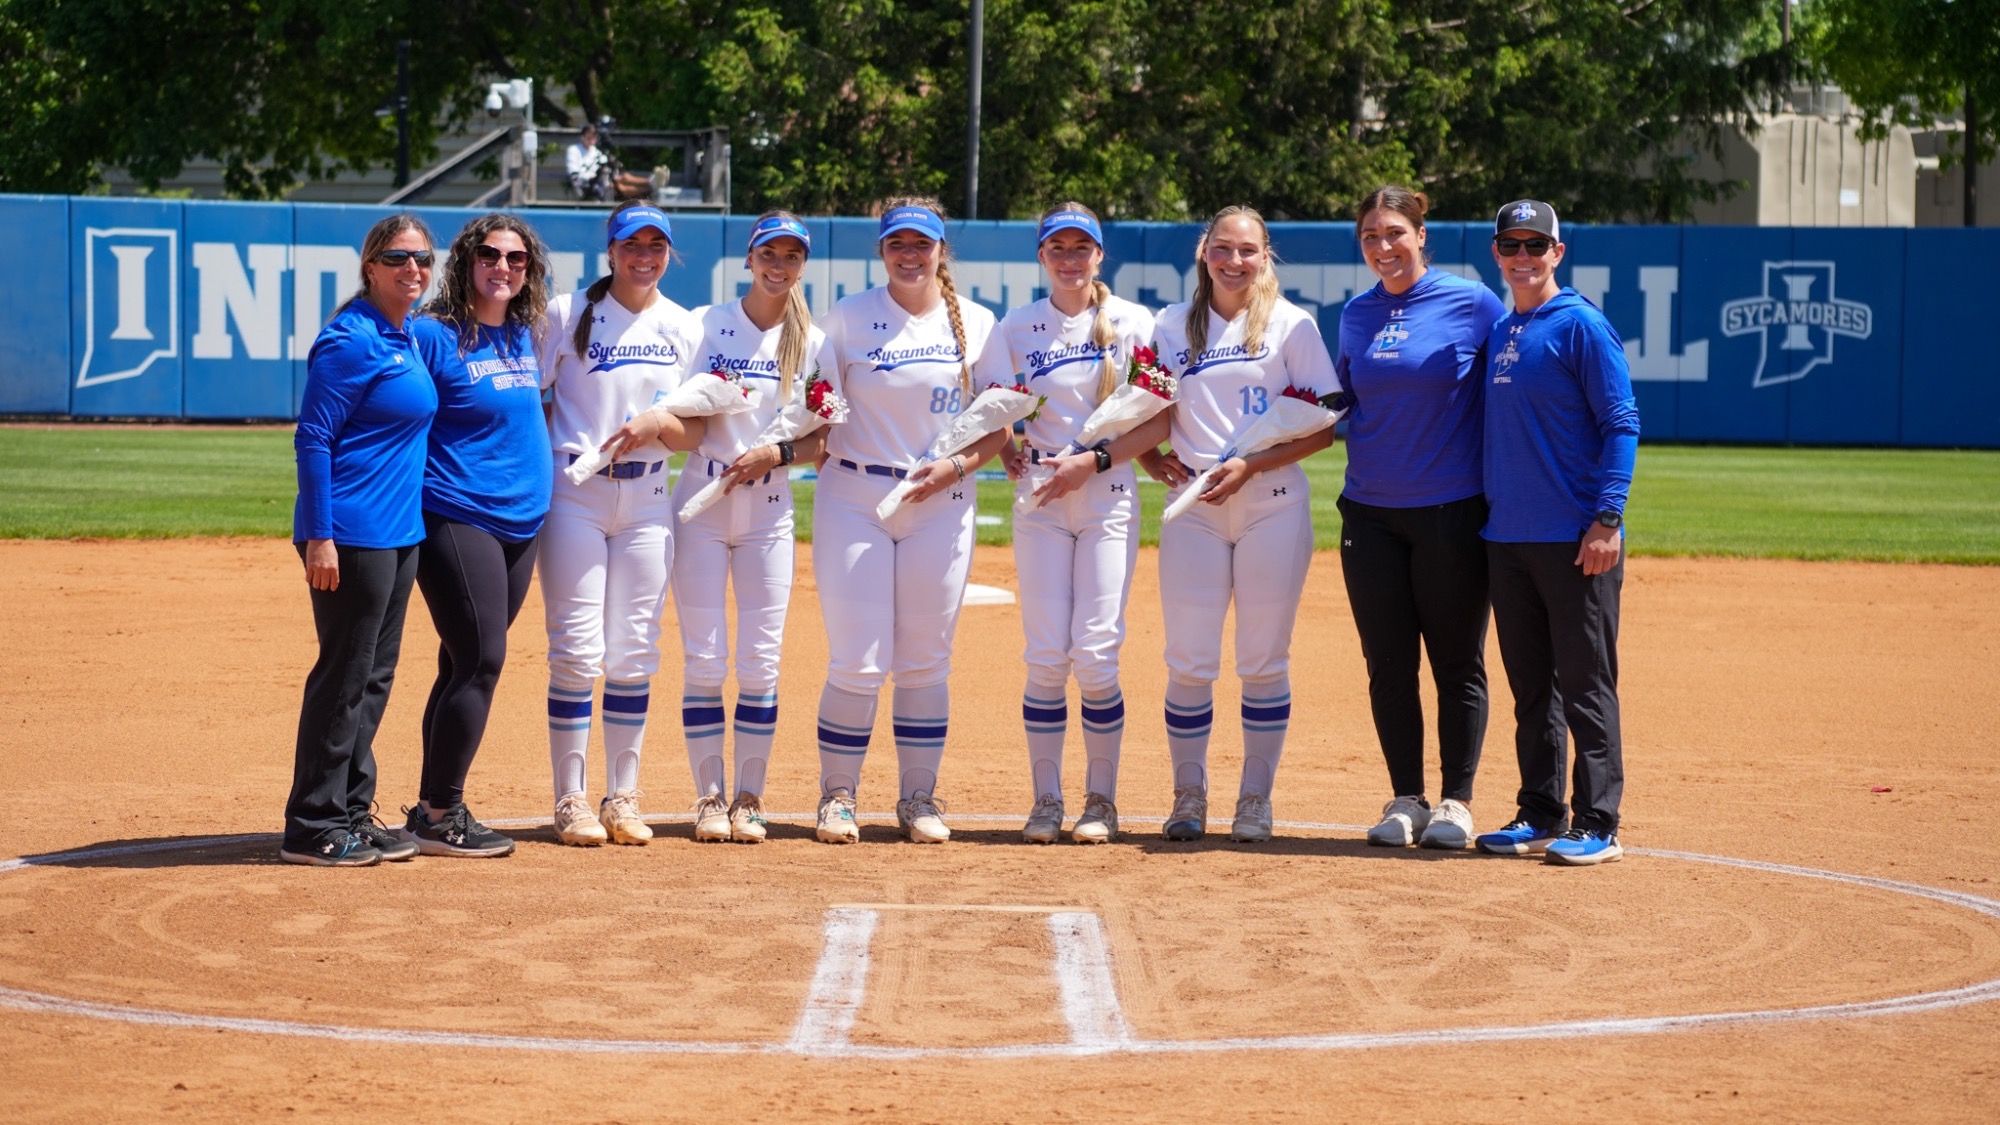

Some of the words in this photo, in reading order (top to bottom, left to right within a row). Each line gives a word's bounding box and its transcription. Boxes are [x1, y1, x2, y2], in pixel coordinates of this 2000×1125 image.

[1728, 301, 1867, 332] SYCAMORES
[588, 342, 677, 364] Sycamores
[867, 343, 964, 363] Sycamores
[929, 386, 962, 414] 88
[1239, 385, 1268, 415] 13
